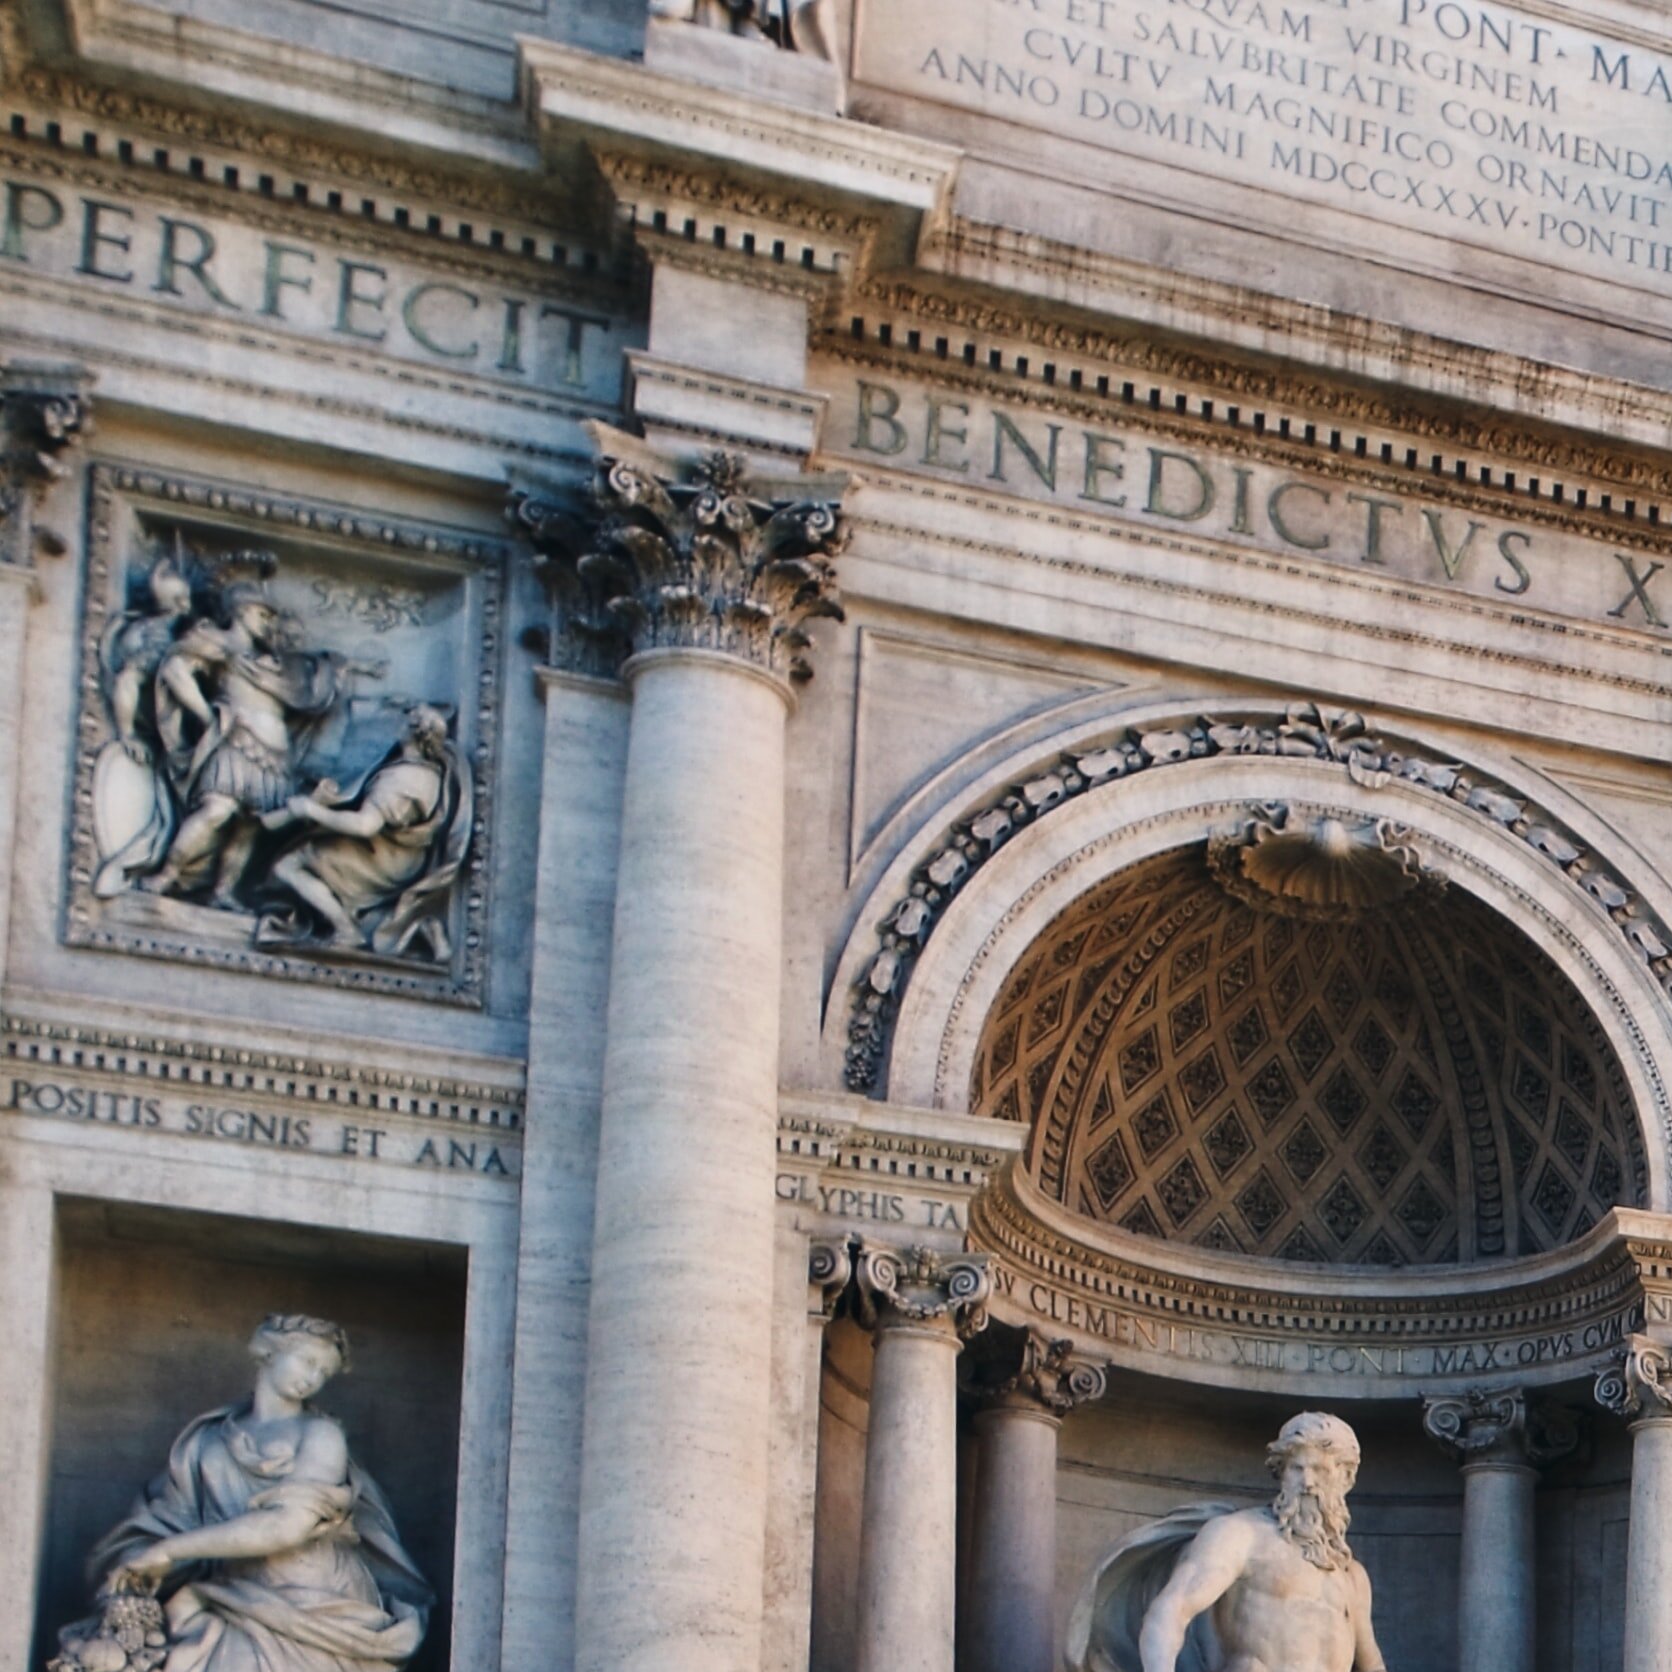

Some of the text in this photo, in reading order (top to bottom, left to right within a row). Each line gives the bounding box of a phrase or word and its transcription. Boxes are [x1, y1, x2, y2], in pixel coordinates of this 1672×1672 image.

[920, 48, 1059, 107] ANNO
[1078, 88, 1247, 159] DOMINI
[1066, 0, 1115, 29] ET
[1133, 12, 1415, 116] SALVBRITATE
[1344, 26, 1560, 114] VIRGINEM
[1023, 28, 1666, 228] CVLTV MAGNIFICO ORNAVIT
[0, 181, 610, 390] PERFECIT
[849, 379, 1532, 594] BENEDICTVS
[10, 1079, 509, 1175] POSITIS SIGNIS ET ANA
[775, 1173, 962, 1230] GLYPHIS TA
[1517, 1333, 1574, 1365] OPVS
[1583, 1314, 1623, 1349] CVM
